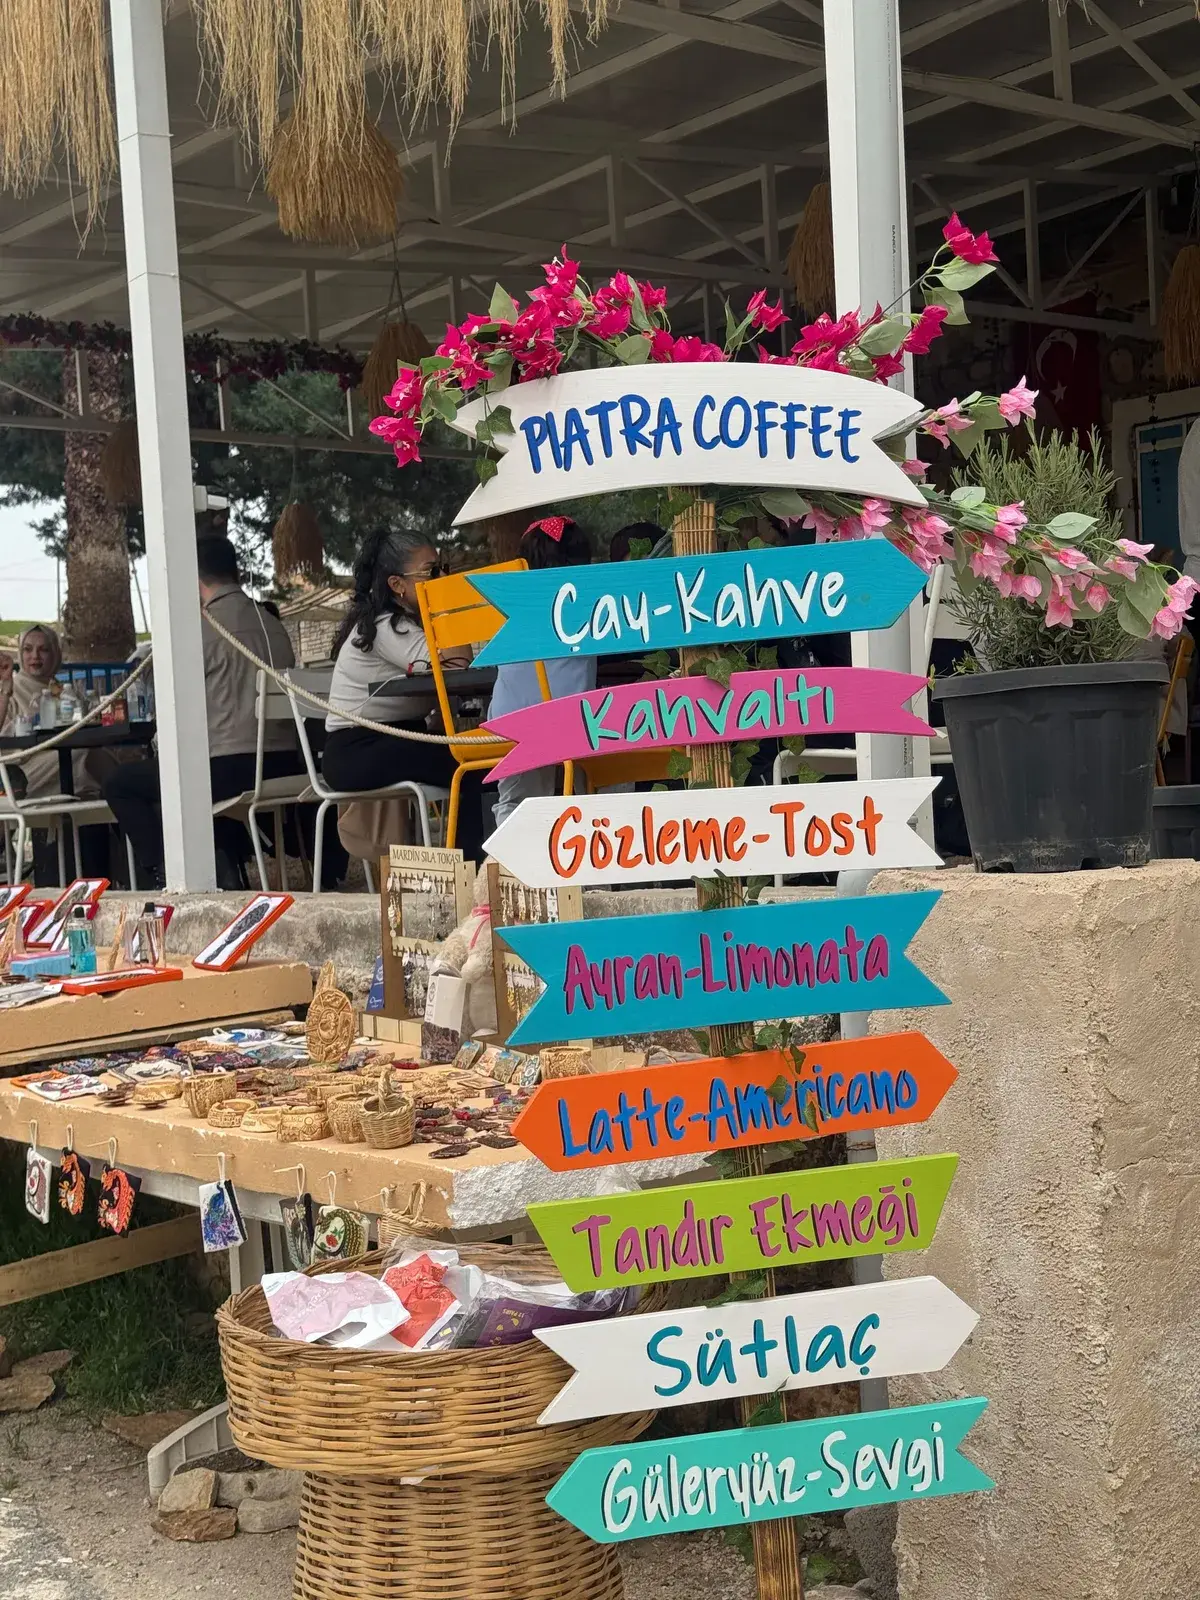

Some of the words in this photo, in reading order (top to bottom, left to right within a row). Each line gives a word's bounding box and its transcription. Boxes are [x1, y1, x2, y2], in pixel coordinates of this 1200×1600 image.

[519, 393, 683, 474] PIATRA
[692, 394, 862, 464] COFFEE
[551, 562, 848, 652] Çay-Kahve
[580, 673, 835, 751] Kahvaltı
[549, 795, 884, 879] Gözleme-Tost
[563, 924, 890, 1015] Ayran-Limonata
[557, 1064, 919, 1157] Latte-Americano
[571, 1198, 734, 1278] Tandır
[748, 1177, 919, 1258] Ekmeği
[646, 1312, 880, 1397] Sütlaç
[601, 1421, 945, 1534] Güleryüz-Sevgi
